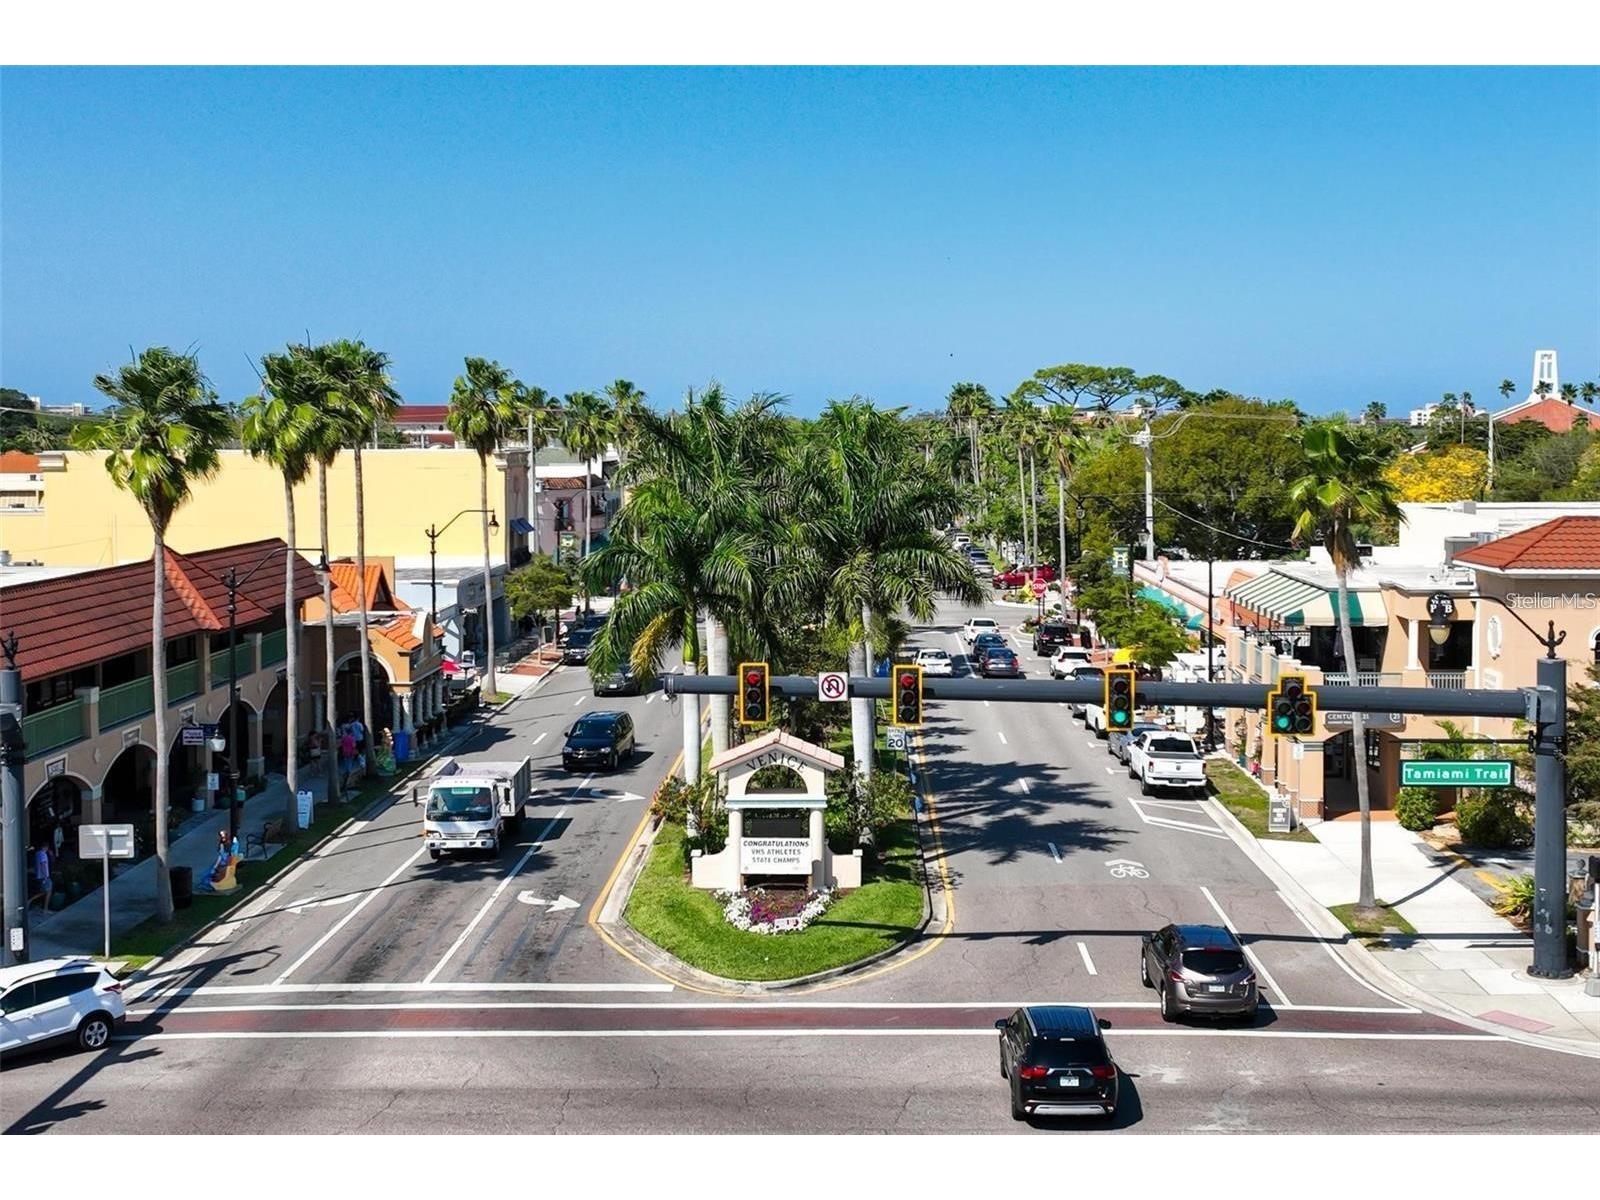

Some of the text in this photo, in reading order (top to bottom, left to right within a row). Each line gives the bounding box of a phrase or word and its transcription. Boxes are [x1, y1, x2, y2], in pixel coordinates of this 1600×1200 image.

[1430, 604, 1453, 613] PB
[888, 738, 903, 748] 20
[746, 752, 808, 773] VENICE
[1405, 768, 1509, 779] Tamiami Trail
